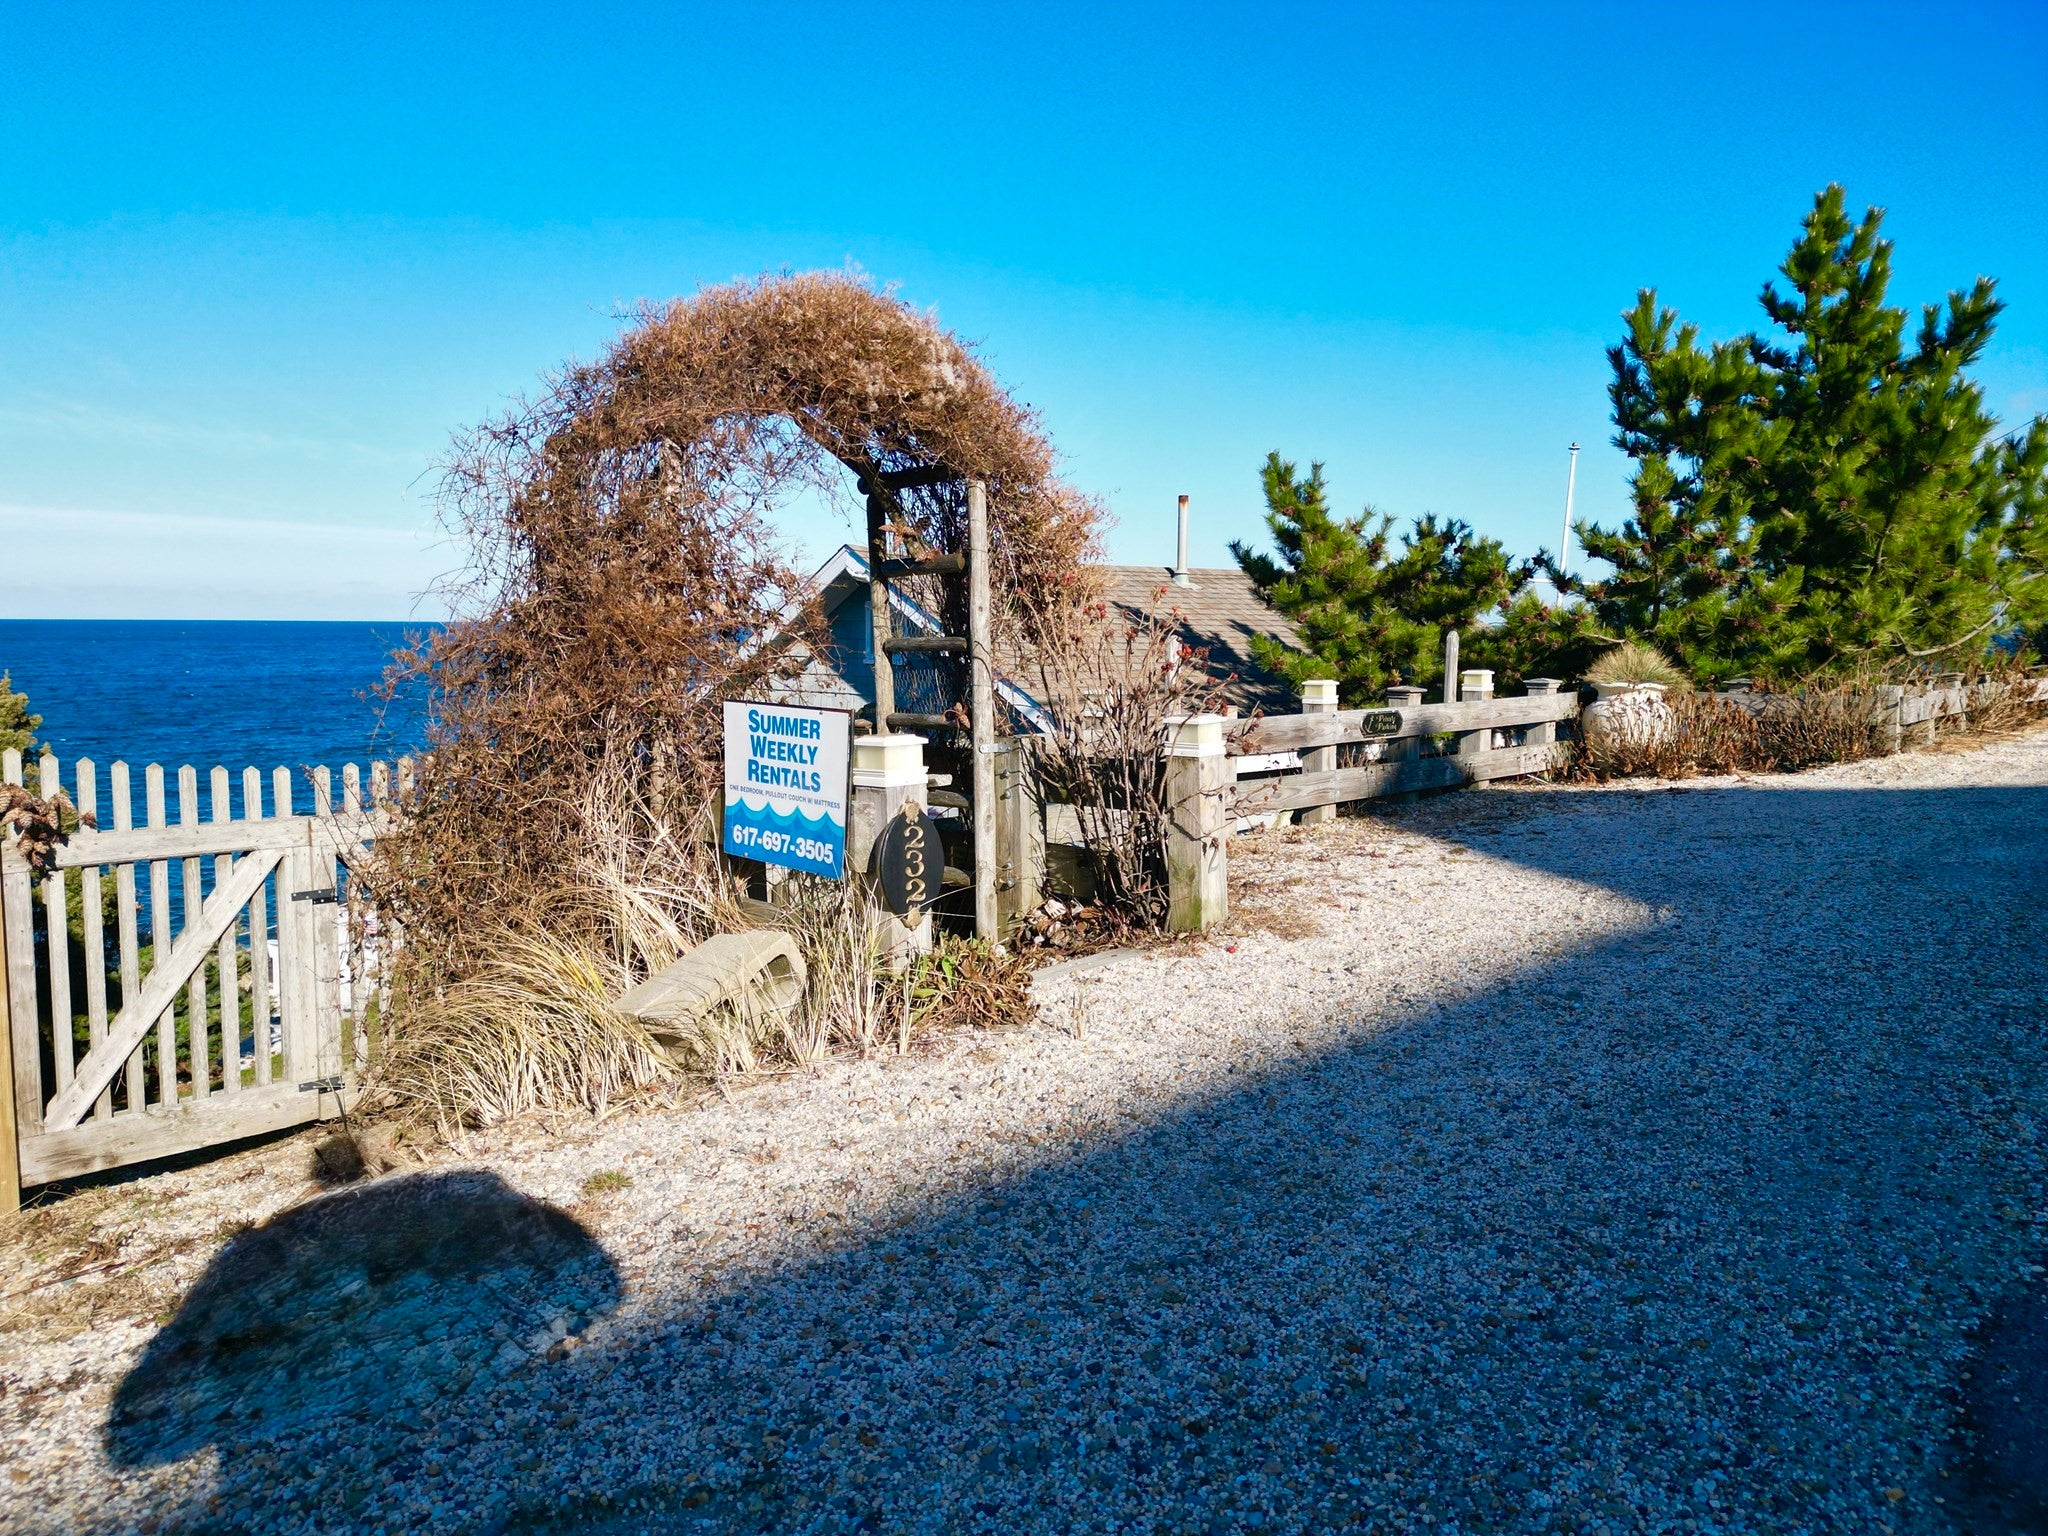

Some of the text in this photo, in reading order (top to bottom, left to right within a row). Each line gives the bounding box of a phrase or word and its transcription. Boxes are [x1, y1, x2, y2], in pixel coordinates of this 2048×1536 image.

[748, 709, 821, 740] SUMMER
[1375, 722, 1397, 732] Parking
[750, 735, 818, 765] WEEKLY
[747, 759, 821, 792] RENTALS
[765, 790, 787, 800] PULLOUT
[788, 794, 806, 803] COUCH
[813, 798, 840, 810] MATTRESS
[733, 824, 834, 865] 617-697-3505
[904, 826, 926, 904] 232
